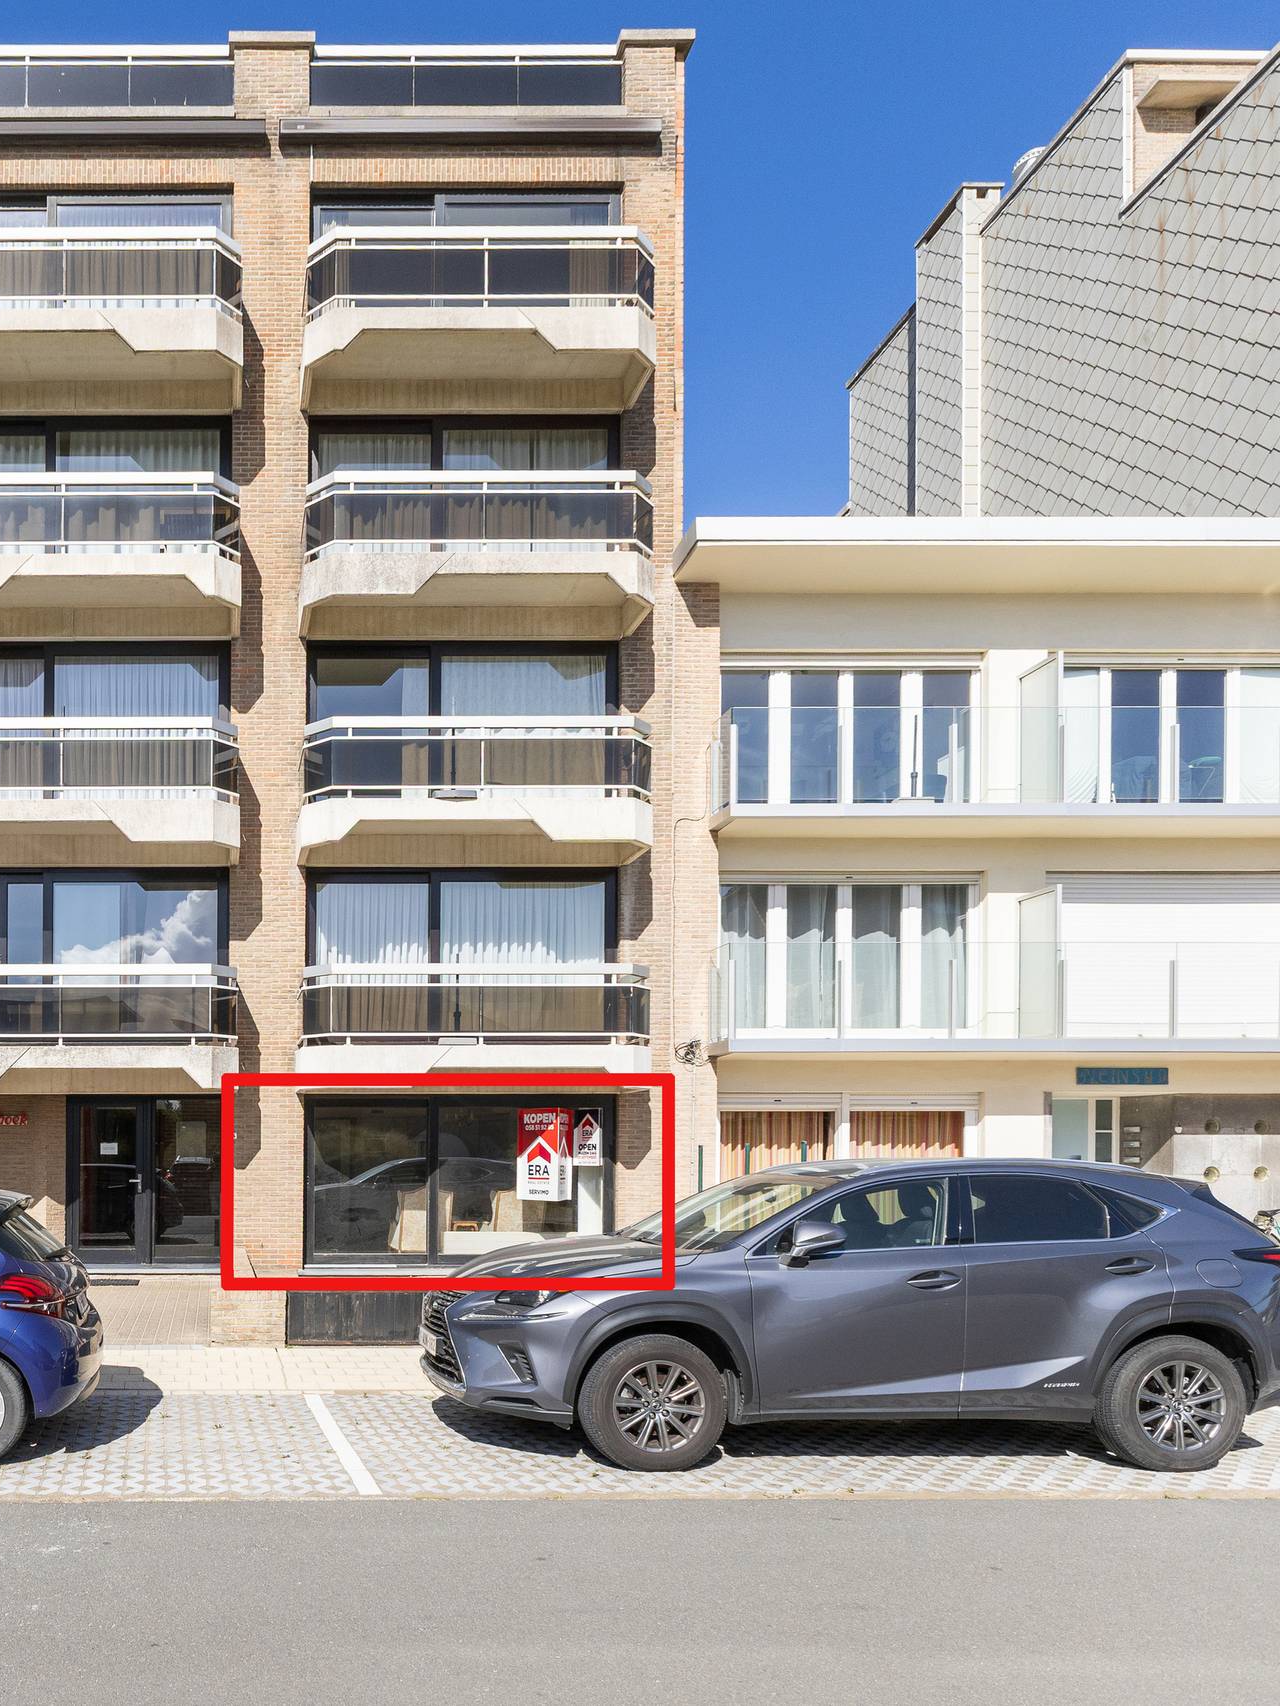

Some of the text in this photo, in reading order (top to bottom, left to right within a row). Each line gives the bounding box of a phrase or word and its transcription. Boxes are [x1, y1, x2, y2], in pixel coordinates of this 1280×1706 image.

[524, 1112, 556, 1124] KOPEN
[578, 1143, 597, 1151] OPEN
[528, 1164, 550, 1176] ERA
